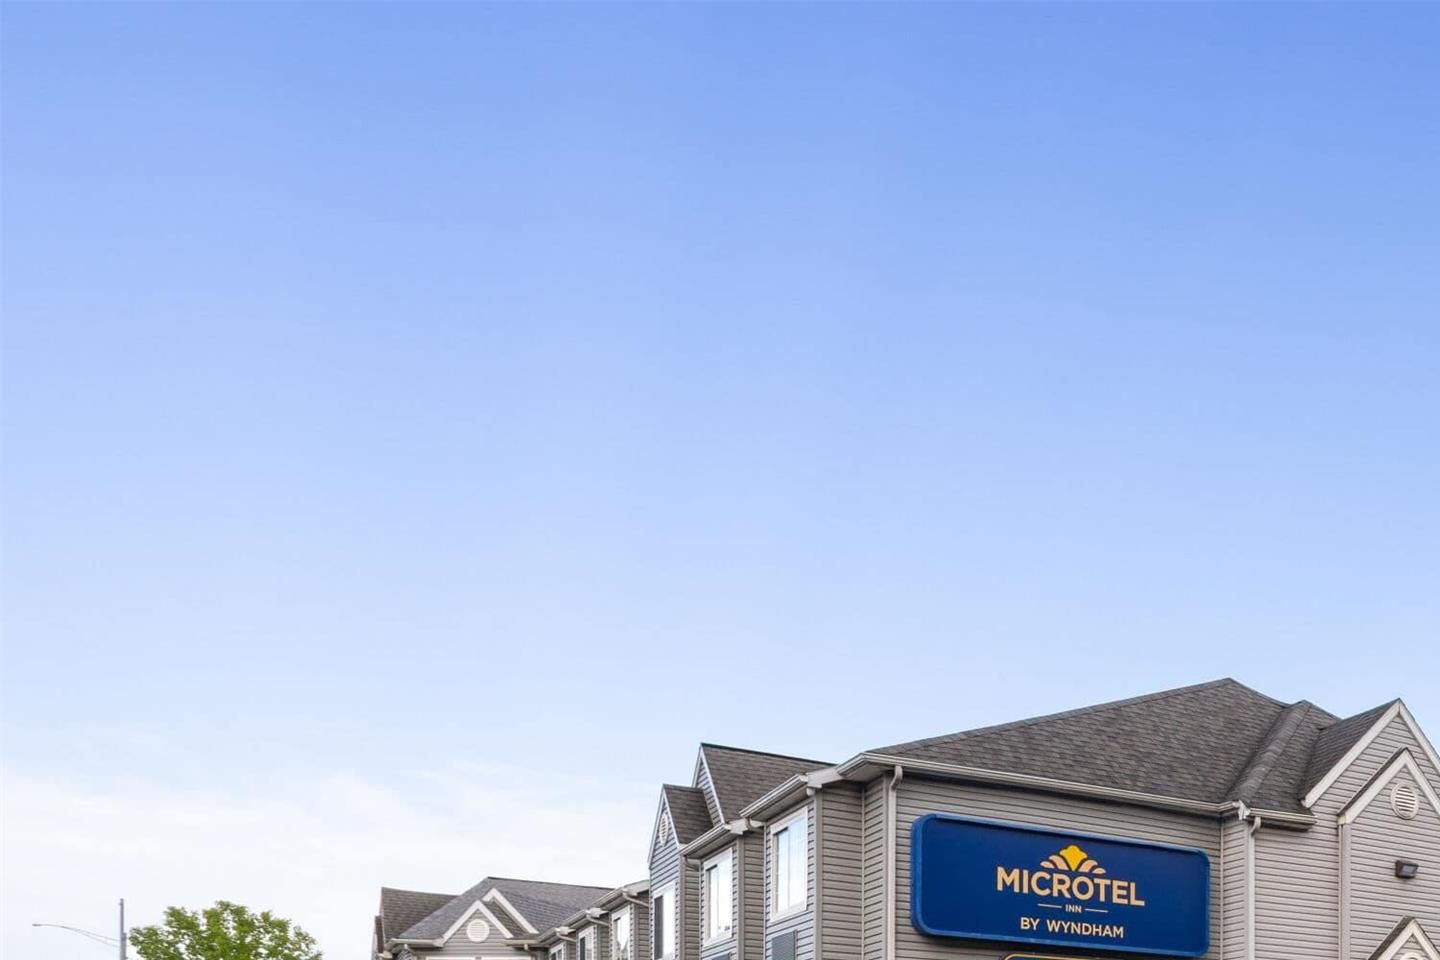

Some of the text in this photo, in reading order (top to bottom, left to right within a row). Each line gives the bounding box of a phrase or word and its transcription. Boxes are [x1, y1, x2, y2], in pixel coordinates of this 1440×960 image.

[996, 866, 1145, 906] MICROTEL
[1065, 904, 1082, 913] INN
[1020, 917, 1124, 938] BY WYNDHAM
